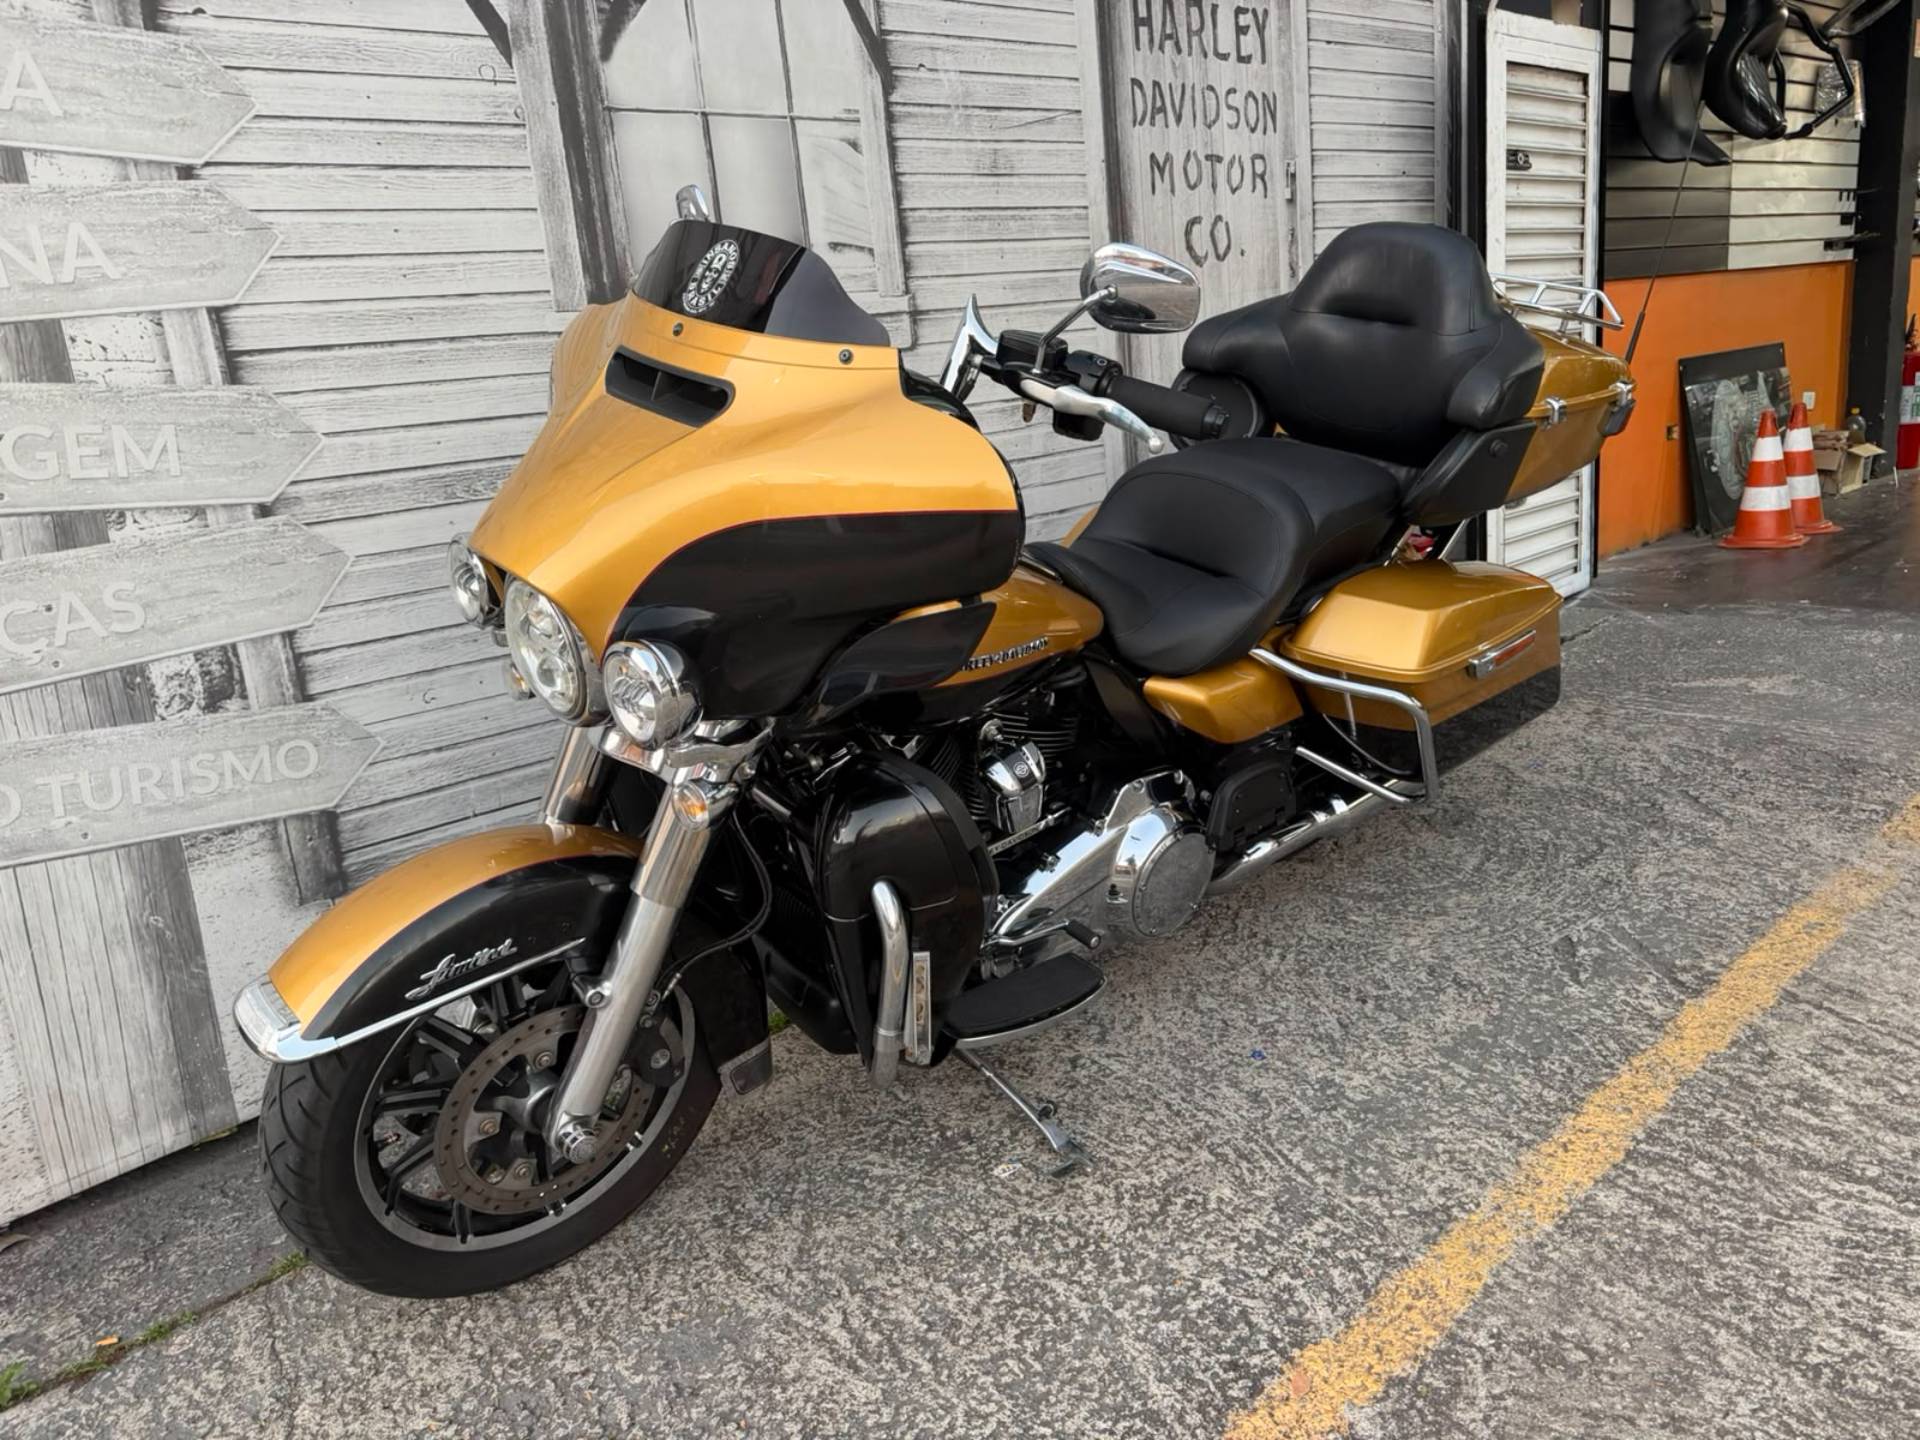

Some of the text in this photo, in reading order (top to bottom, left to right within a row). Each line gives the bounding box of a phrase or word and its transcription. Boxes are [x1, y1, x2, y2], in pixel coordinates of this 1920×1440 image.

[1132, 0, 1269, 65] HARLEY
[0, 49, 63, 117] A
[1130, 77, 1278, 136] DAVIDSON
[1149, 149, 1268, 199] MOTOR
[1184, 214, 1246, 268] CO.
[0, 424, 182, 481] GEM
[34, 738, 319, 819] TURISMO
[404, 937, 518, 1000] Limited
